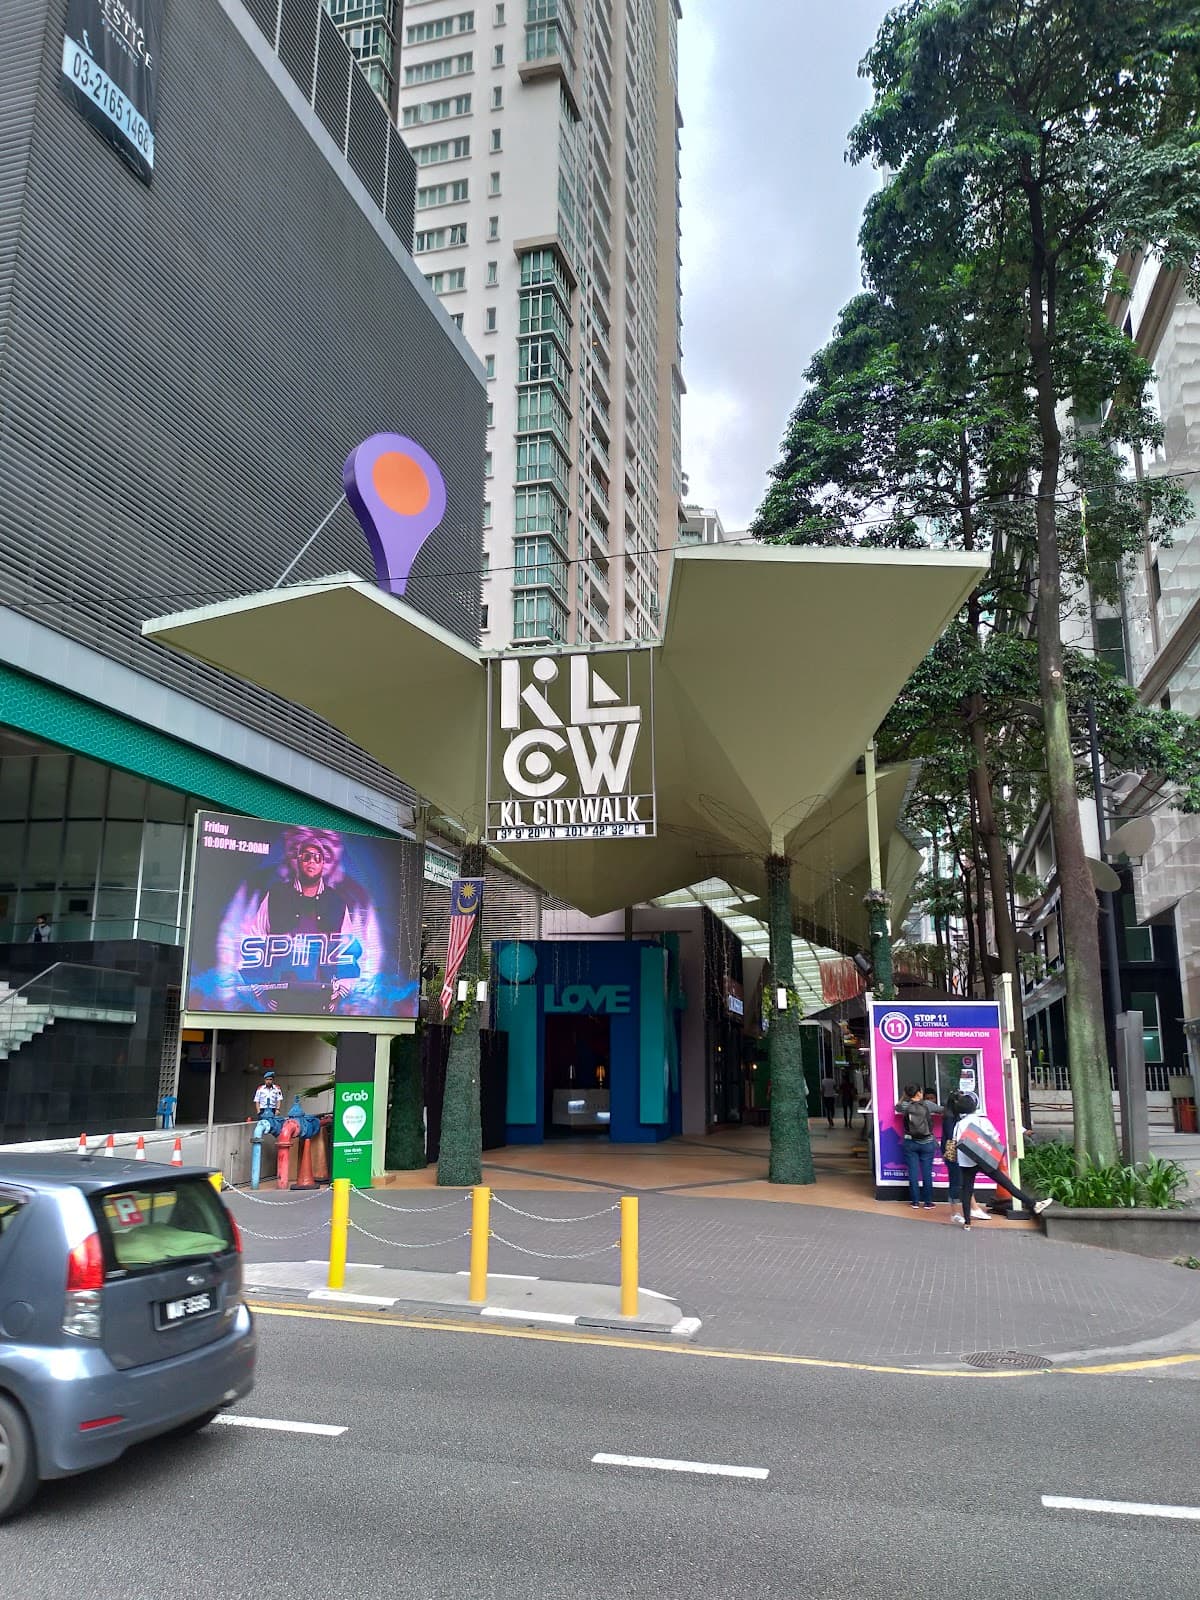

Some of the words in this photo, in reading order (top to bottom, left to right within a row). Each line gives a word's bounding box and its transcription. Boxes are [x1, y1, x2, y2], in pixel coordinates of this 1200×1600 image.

[73, 52, 123, 121] 03-2165
[126, 109, 149, 153] 1468
[501, 654, 641, 730] KL
[503, 723, 640, 797] CW
[501, 801, 526, 826] KL
[533, 796, 641, 825] CITYWALK
[204, 820, 230, 836] Friday
[203, 835, 270, 855] 10:00PM-12:00AM
[544, 984, 631, 1013] LOVE
[889, 1022, 902, 1034] 11
[914, 1014, 936, 1022] STOP
[937, 1014, 947, 1022] 11
[341, 1089, 369, 1102] Grab
[114, 1198, 137, 1222] P
